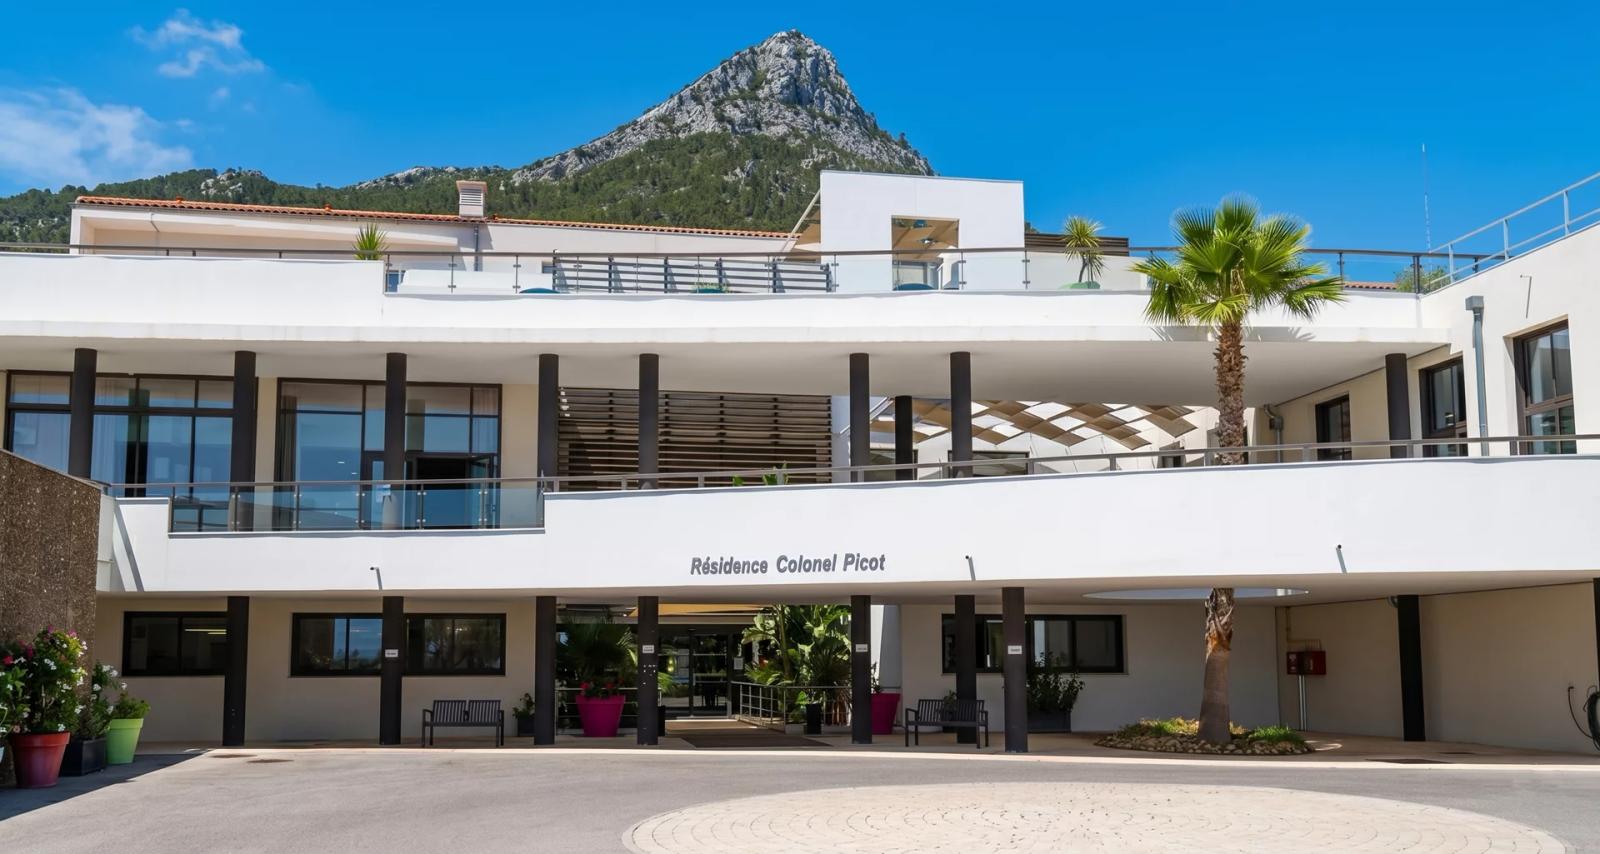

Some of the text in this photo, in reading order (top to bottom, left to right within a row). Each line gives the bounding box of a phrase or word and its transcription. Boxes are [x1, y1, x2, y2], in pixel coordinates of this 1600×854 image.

[691, 553, 885, 575] Résidence Colonel Picot
